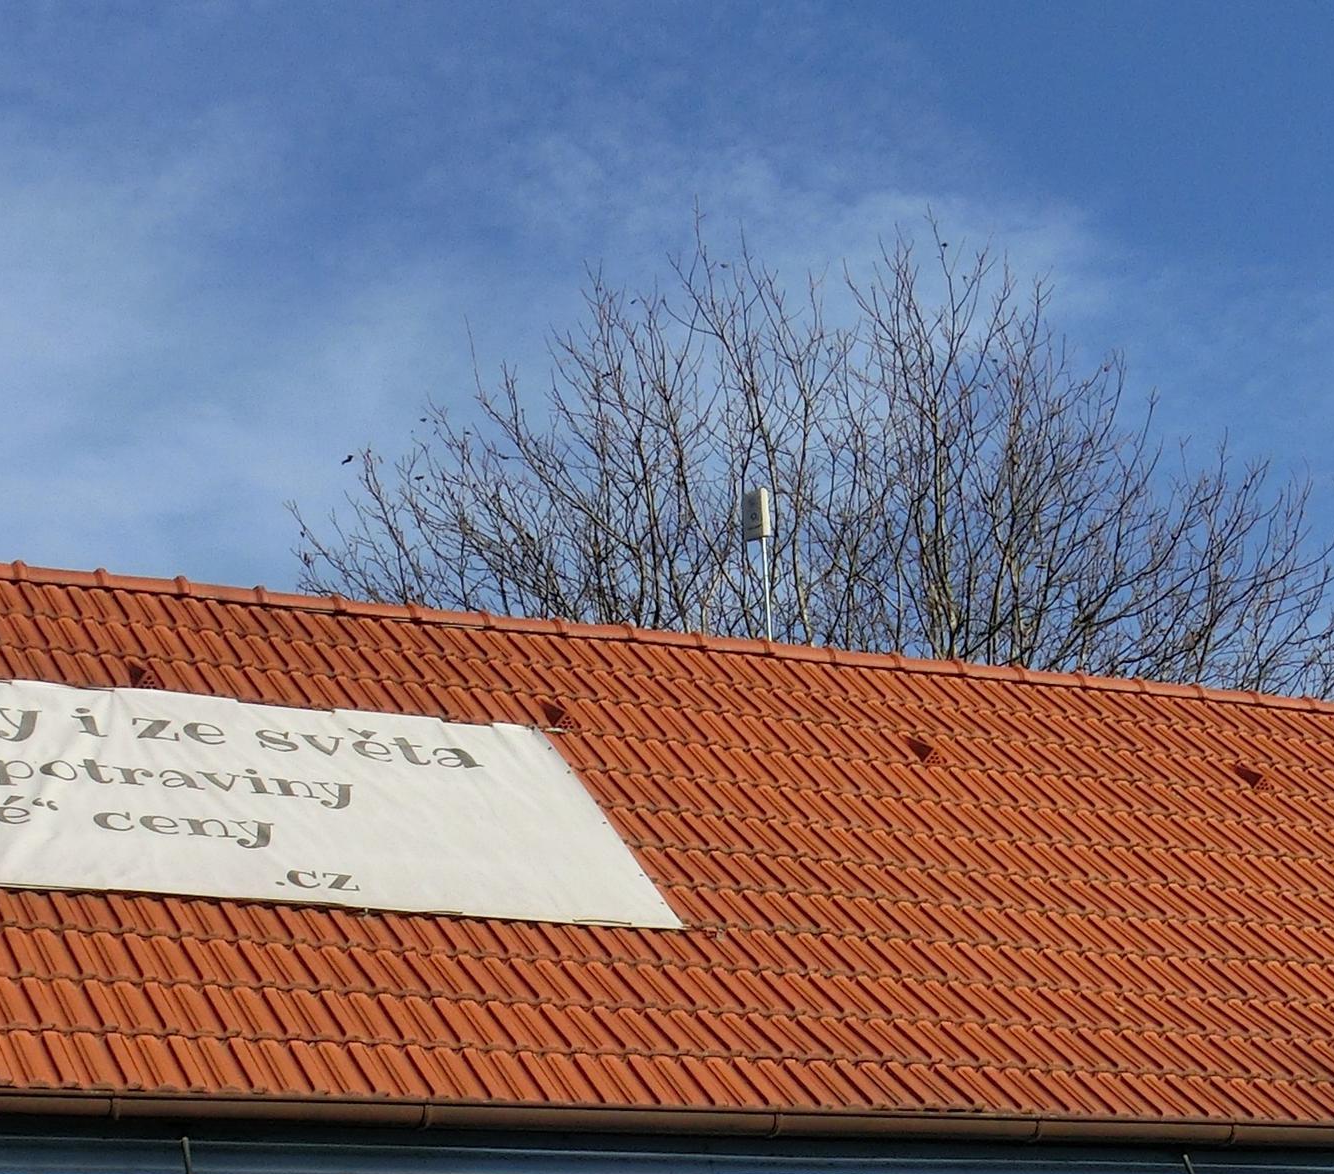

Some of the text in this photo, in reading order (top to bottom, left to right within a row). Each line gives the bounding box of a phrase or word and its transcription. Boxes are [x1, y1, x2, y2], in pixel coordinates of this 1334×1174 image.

[72, 706, 108, 739] i
[132, 714, 226, 746] ze
[257, 727, 484, 769] světa
[94, 806, 274, 850] ceny
[274, 867, 362, 894] .cz
